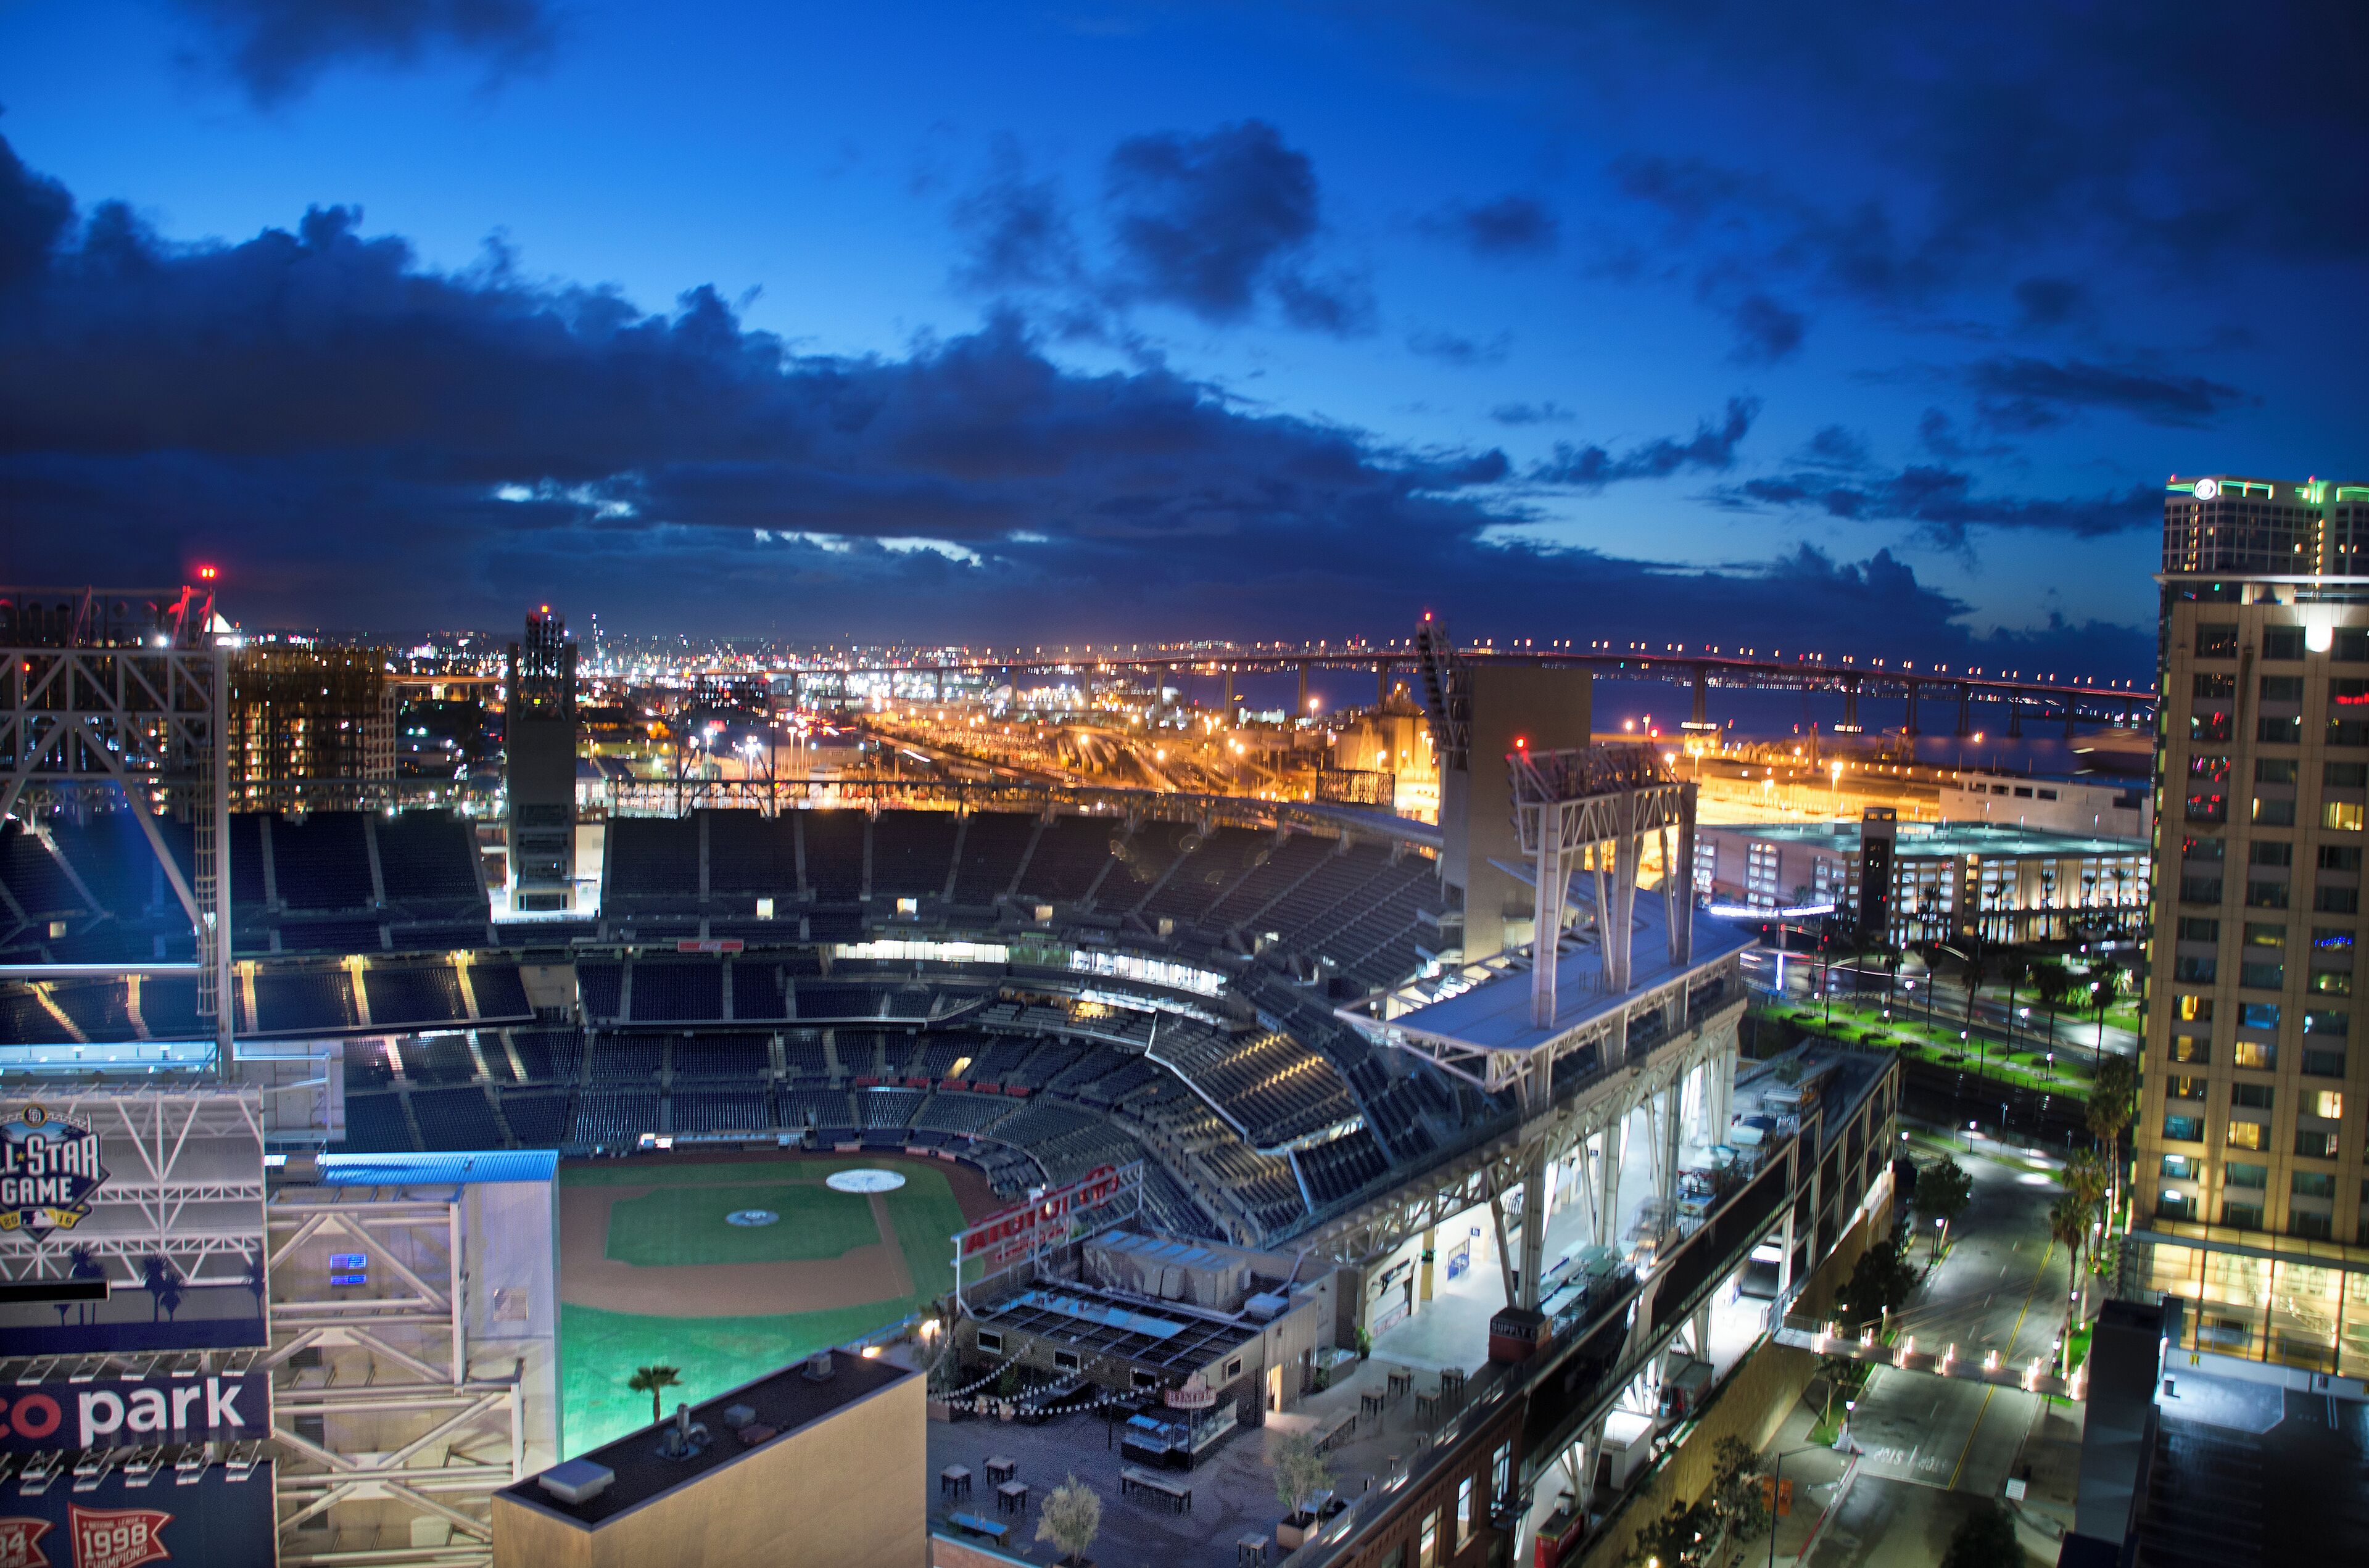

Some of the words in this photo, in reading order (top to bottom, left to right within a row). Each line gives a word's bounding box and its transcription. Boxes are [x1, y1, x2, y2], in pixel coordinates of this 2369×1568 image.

[27, 1134, 99, 1182] STAR
[2, 1176, 73, 1205] GAME
[0, 1394, 62, 1439] o
[79, 1376, 246, 1448] park
[83, 1522, 147, 1560] 1998
